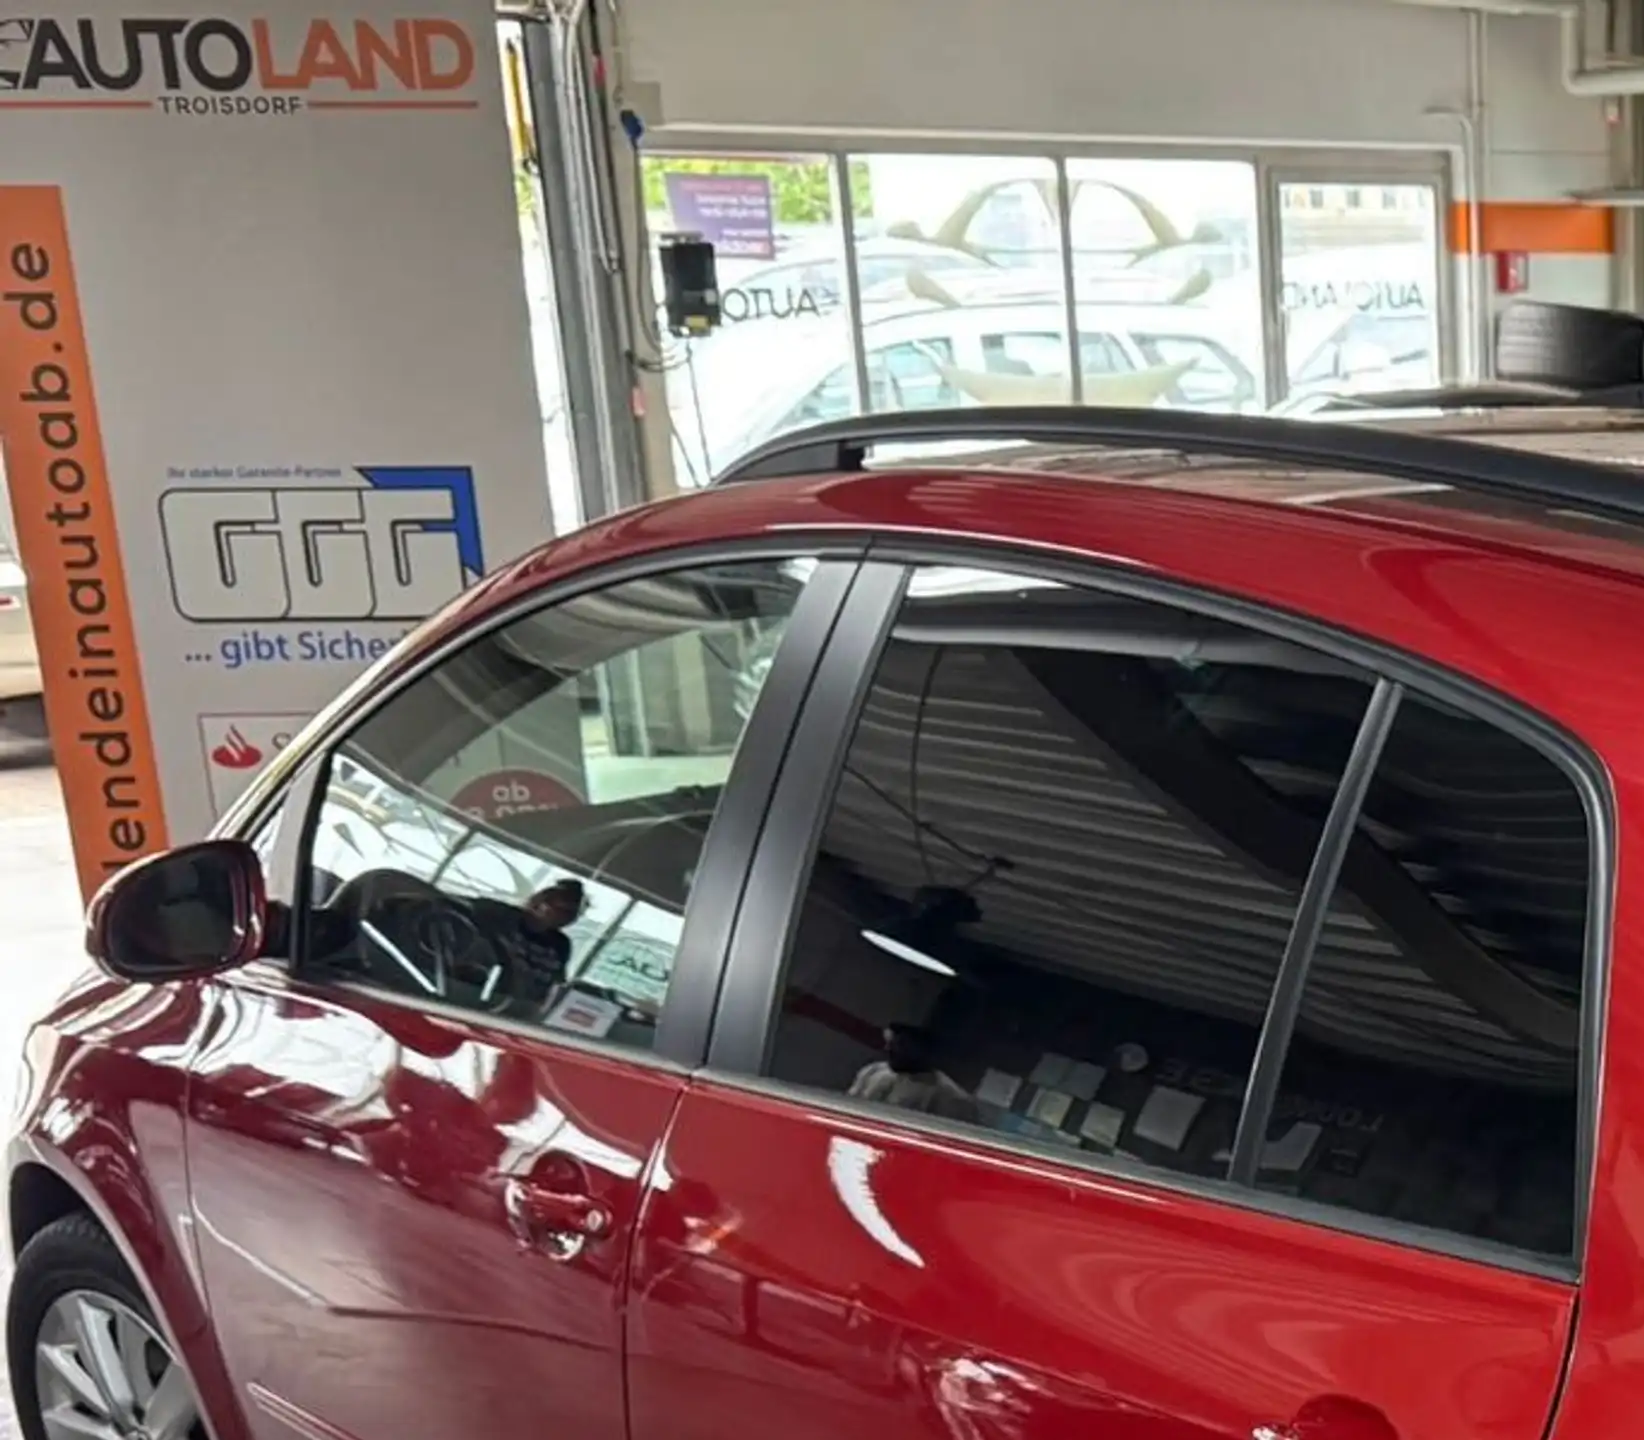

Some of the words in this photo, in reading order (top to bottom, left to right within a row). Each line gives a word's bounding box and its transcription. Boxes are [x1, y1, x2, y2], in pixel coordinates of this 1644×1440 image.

[22, 18, 475, 92] AUTOLAND
[158, 96, 302, 115] TROISDORF
[219, 630, 291, 669] gibt
